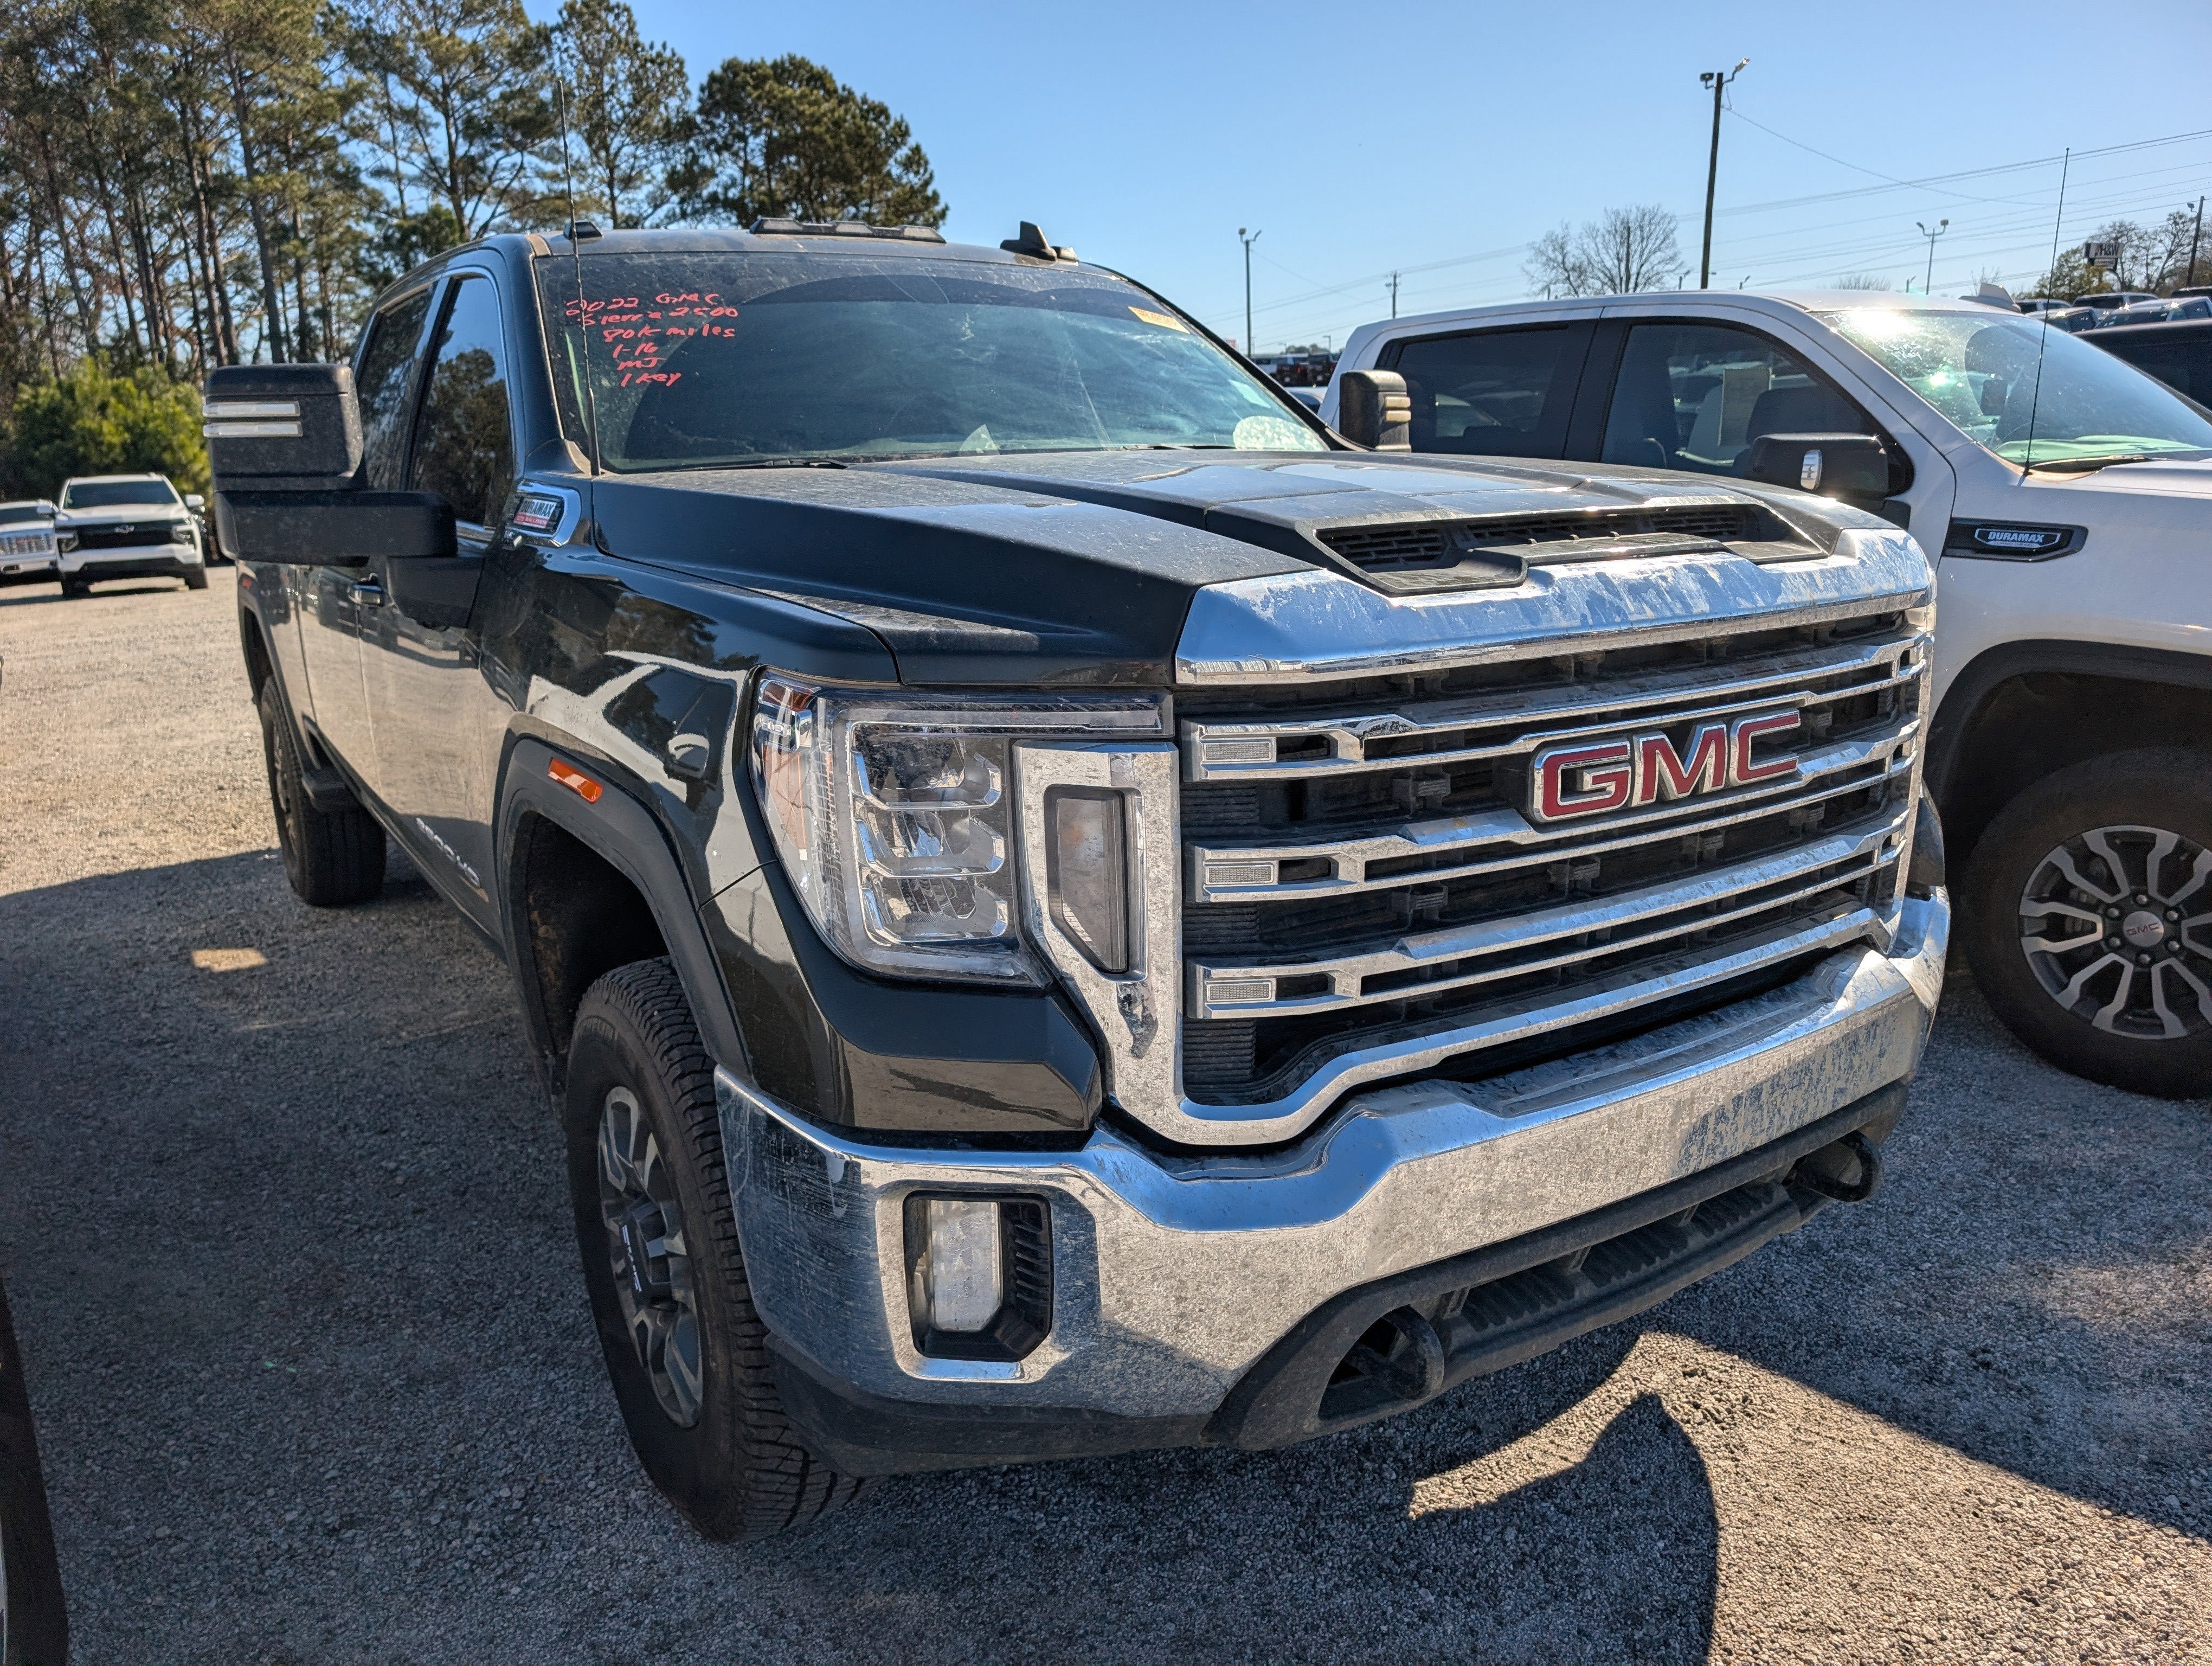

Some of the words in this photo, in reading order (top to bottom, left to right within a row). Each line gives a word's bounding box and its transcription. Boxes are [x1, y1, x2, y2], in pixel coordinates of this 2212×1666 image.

[566, 297, 639, 316] 2022
[655, 293, 719, 305] GMC
[668, 307, 738, 318] 2500
[520, 500, 555, 517] DURAMAX
[1988, 531, 2045, 543] DURAMAX
[1533, 709, 1801, 821] GMC
[2126, 922, 2160, 936] GMC
